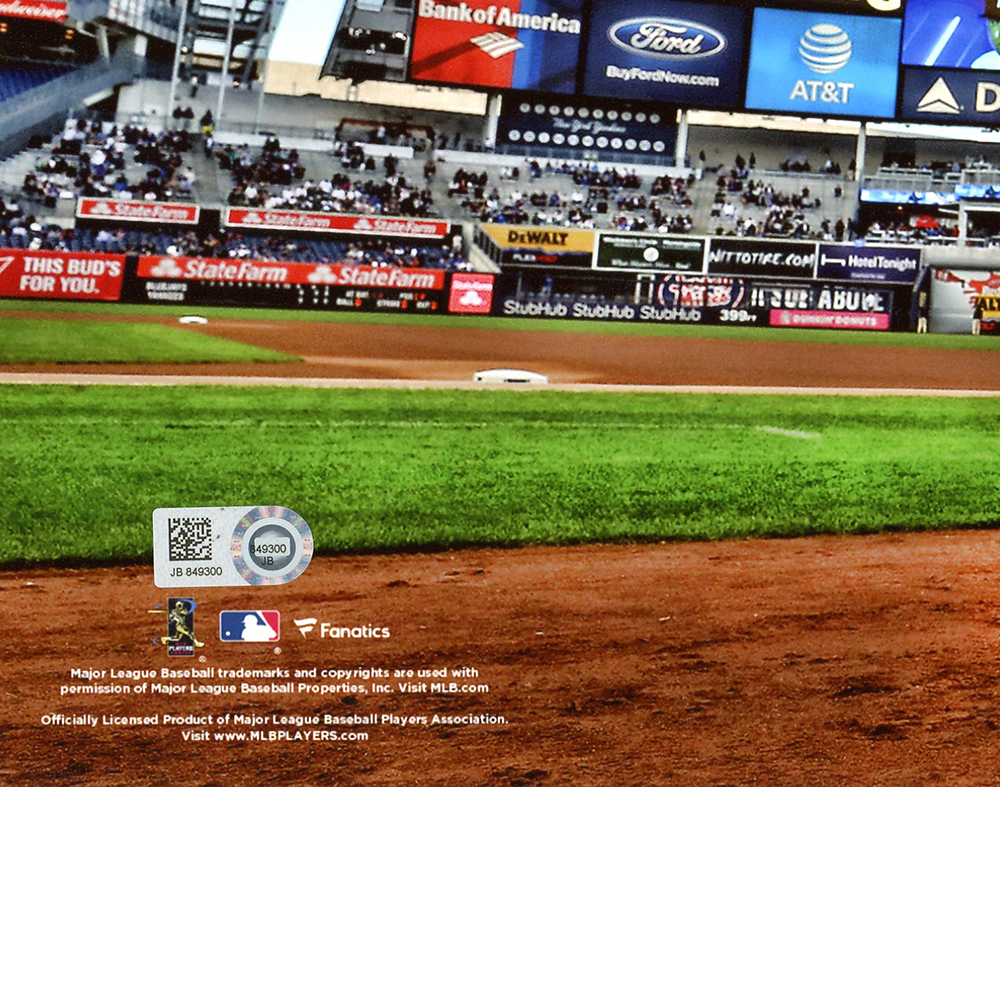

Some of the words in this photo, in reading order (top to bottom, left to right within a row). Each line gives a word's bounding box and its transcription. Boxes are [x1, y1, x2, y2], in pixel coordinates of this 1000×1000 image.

[630, 23, 703, 55] Ford
[606, 65, 719, 88] BuyFordNow.com
[790, 79, 856, 105] AT&T
[24, 256, 63, 274] THIS
[68, 258, 121, 277] BUD'S
[20, 275, 57, 291] FOR
[60, 276, 99, 293] YOU.
[504, 300, 568, 316] StubHub
[572, 302, 635, 319] StubHub
[640, 305, 701, 321] StubHub
[250, 544, 287, 554] 849300
[261, 556, 274, 566] JB
[170, 567, 183, 577] JB
[185, 567, 223, 577] 849300
